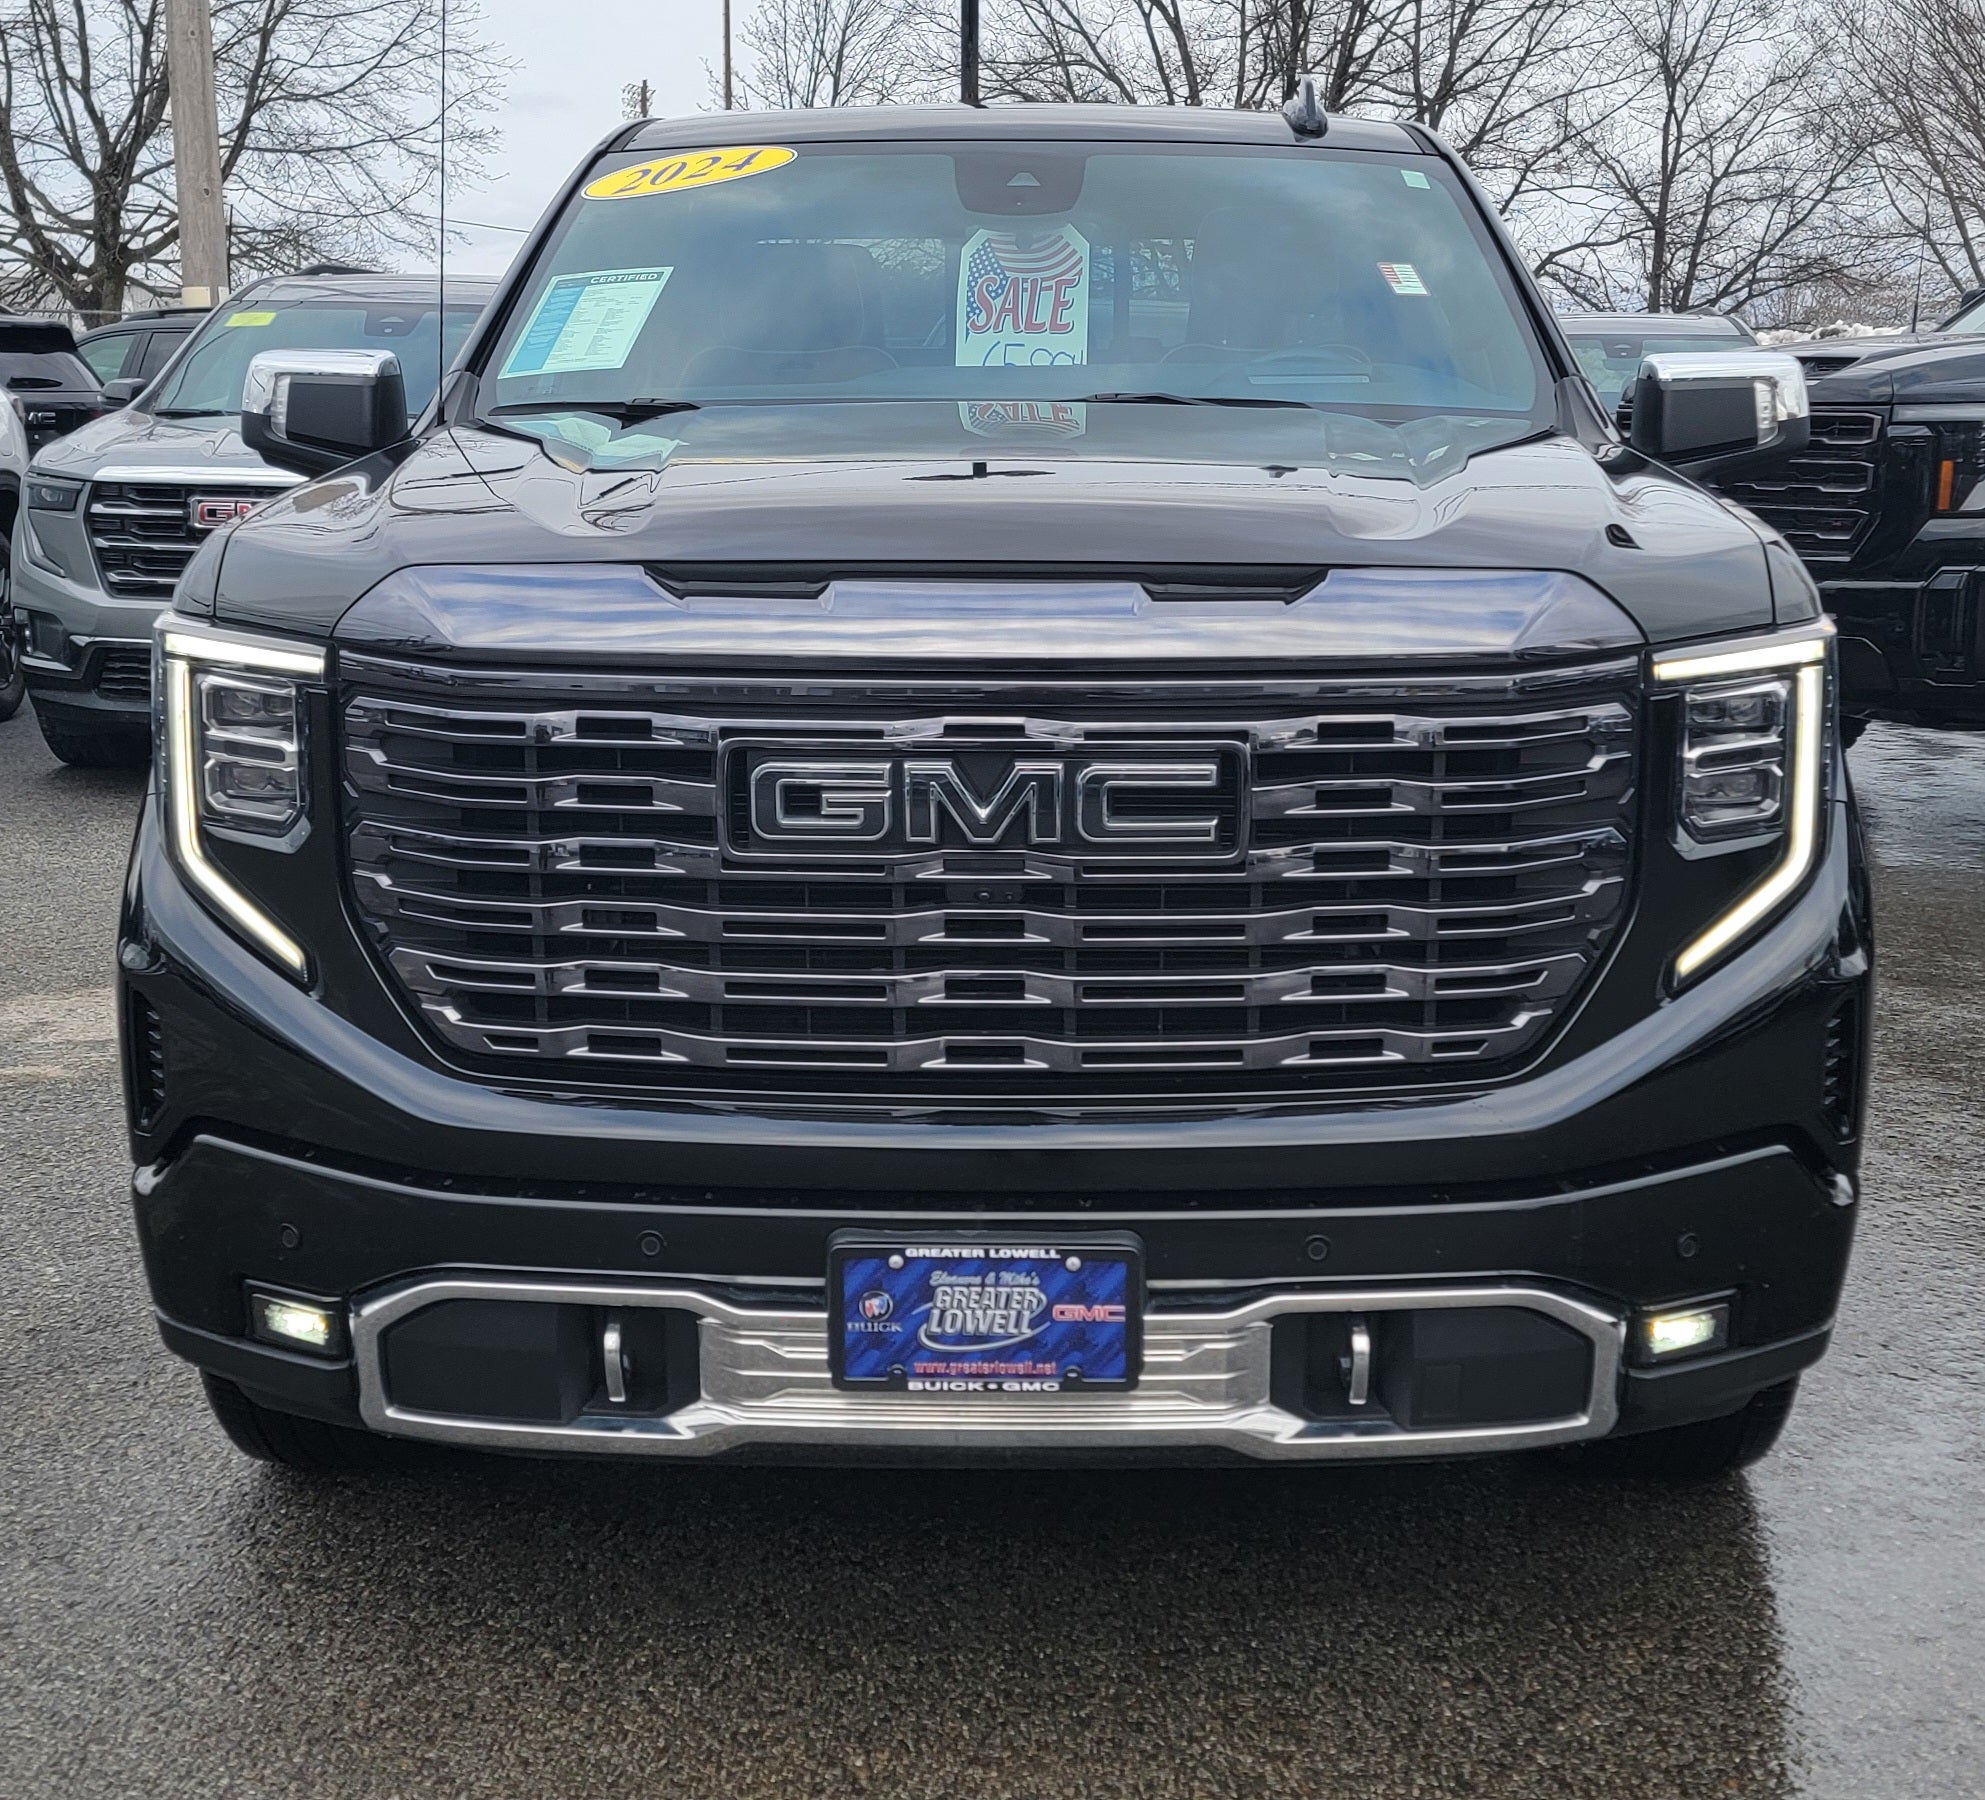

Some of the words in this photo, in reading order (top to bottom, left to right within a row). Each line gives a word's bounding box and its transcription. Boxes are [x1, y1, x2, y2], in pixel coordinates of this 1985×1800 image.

[611, 149, 764, 195] 2024
[590, 273, 658, 284] CERTIFIED
[967, 274, 1081, 334] SALE
[750, 761, 1219, 845] GMC
[905, 1248, 985, 1258] GREATER
[989, 1249, 1061, 1259] LOWELL
[933, 1286, 1041, 1310] GREATER
[926, 1309, 1033, 1336] LOWELL
[1052, 1304, 1126, 1322] GMC
[847, 1322, 903, 1332] BUICK
[907, 1381, 984, 1391] BUICK
[1002, 1381, 1060, 1391] GMC
